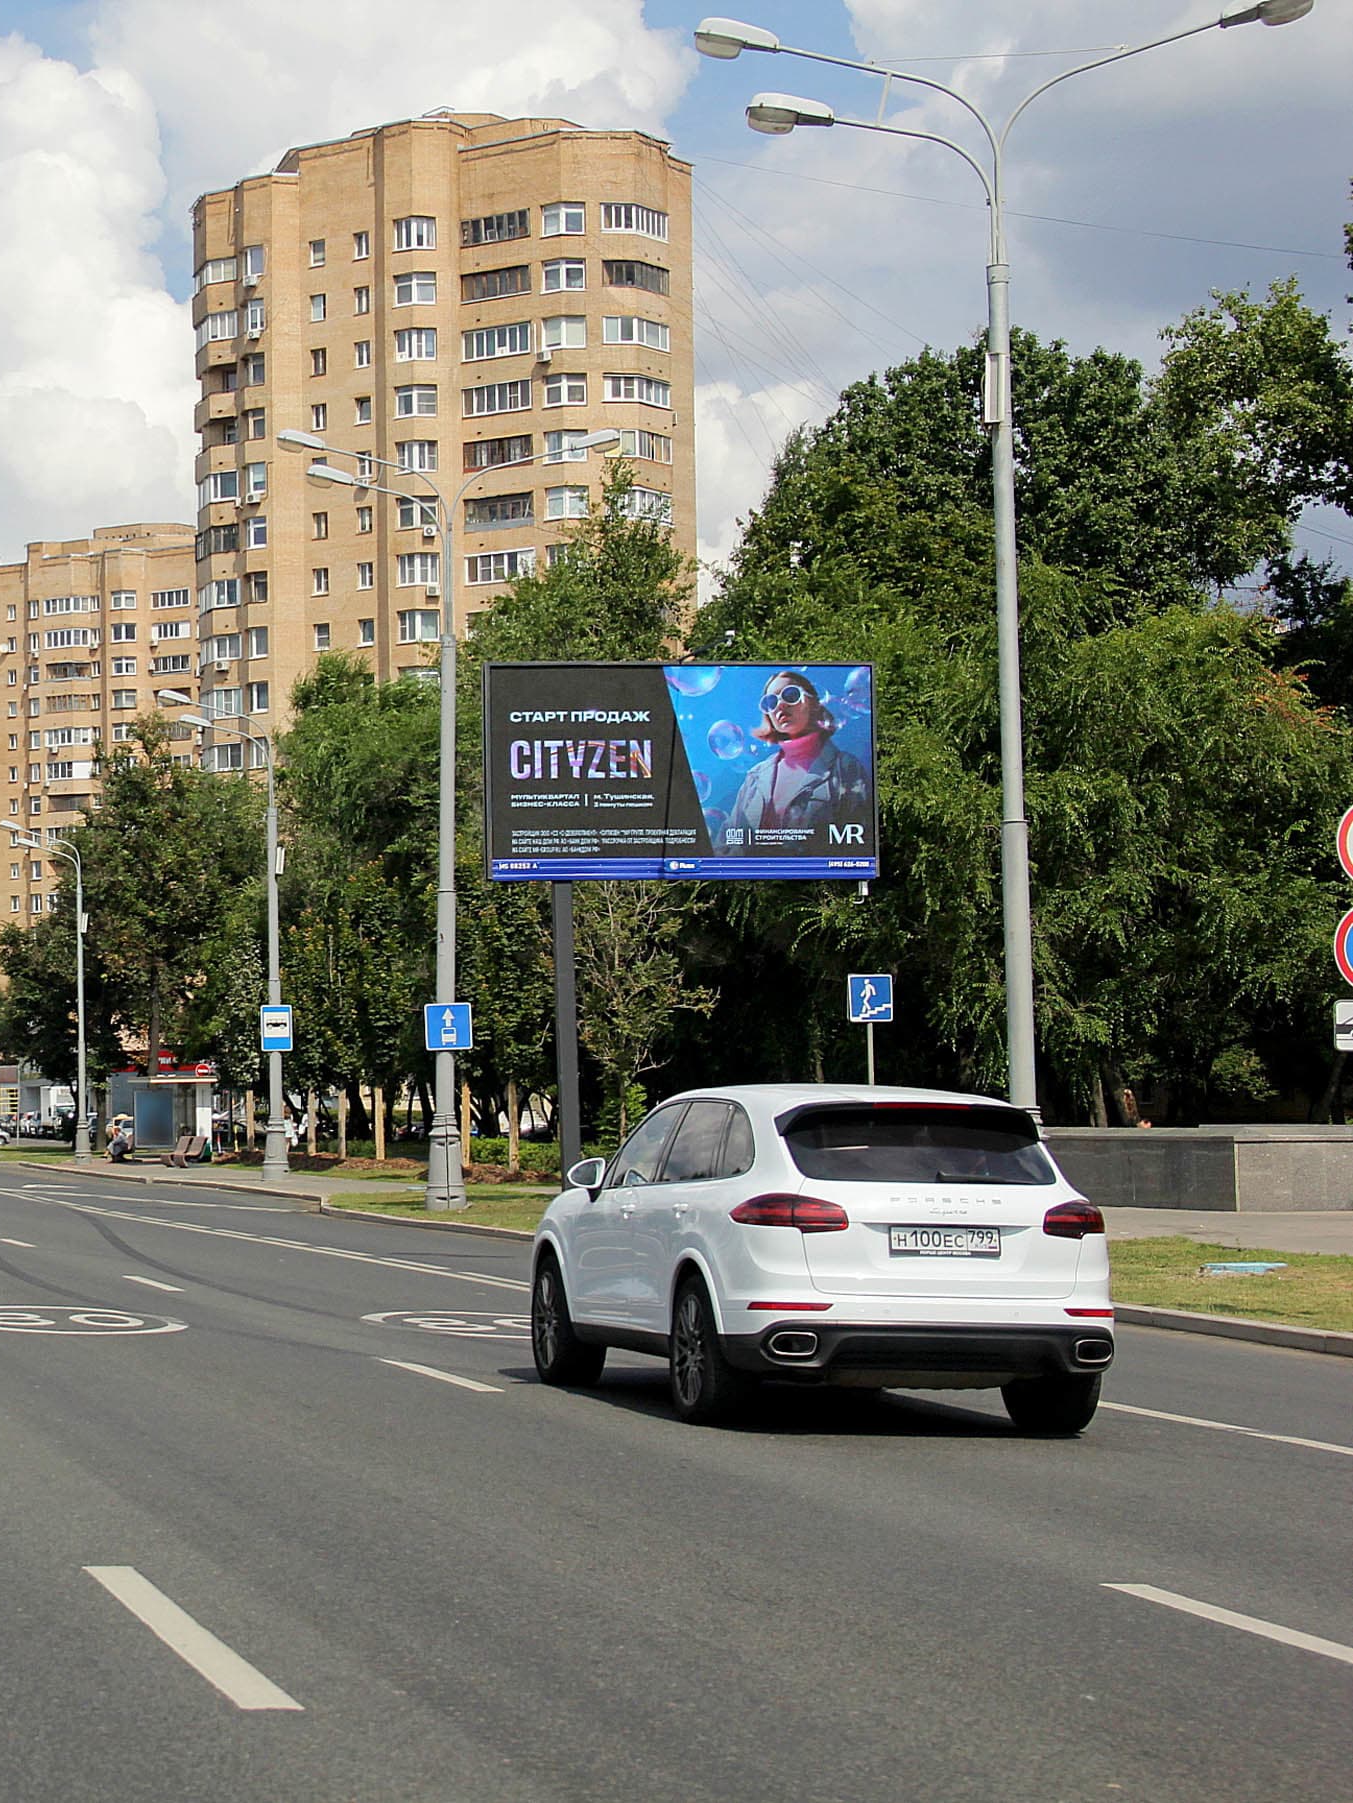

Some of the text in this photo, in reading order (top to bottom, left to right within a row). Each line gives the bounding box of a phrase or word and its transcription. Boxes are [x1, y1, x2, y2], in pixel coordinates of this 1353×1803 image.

[509, 711, 650, 724] СТАРТ ПРОДАЖ
[510, 739, 652, 779] CITYZEN
[828, 823, 865, 844] MR
